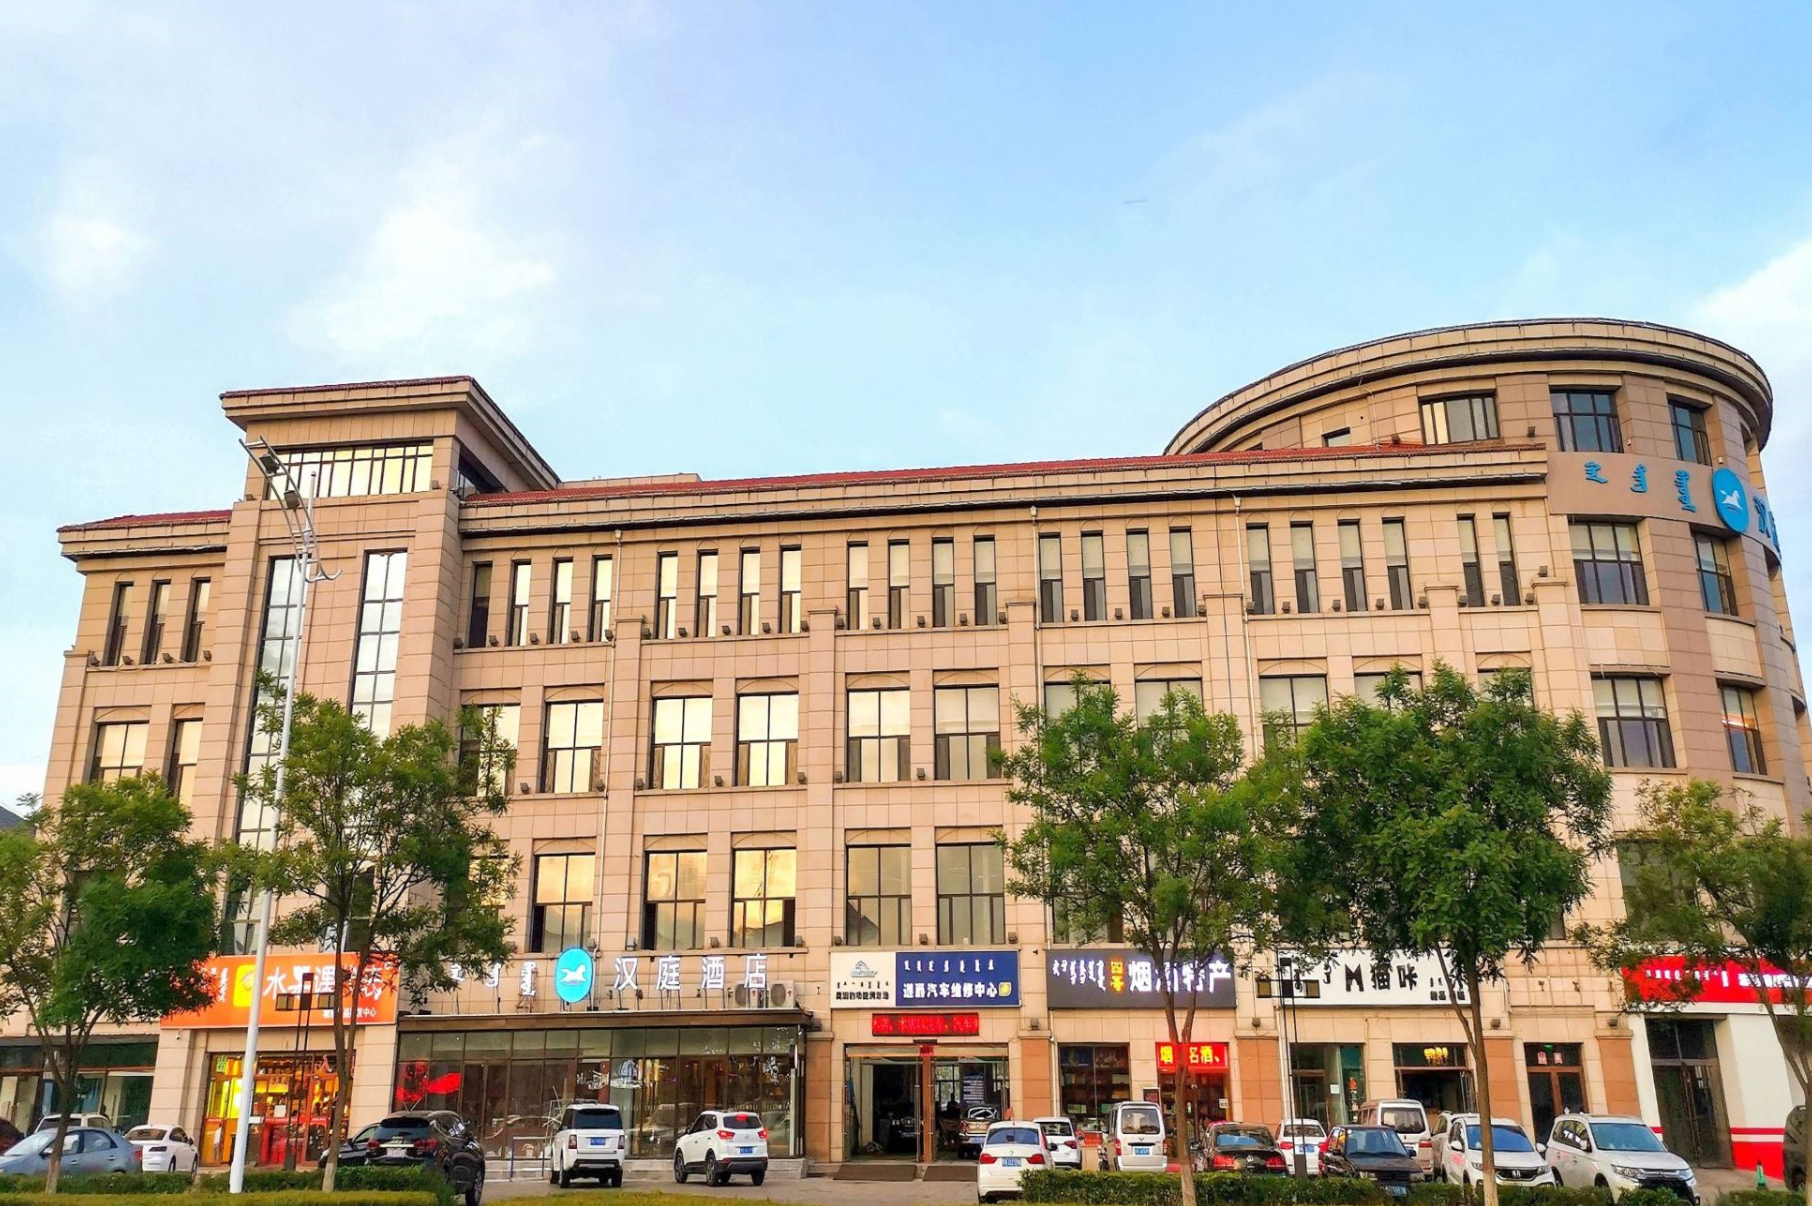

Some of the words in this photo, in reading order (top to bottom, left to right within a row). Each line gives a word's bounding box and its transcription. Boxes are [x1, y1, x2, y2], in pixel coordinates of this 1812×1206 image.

[613, 953, 768, 991] 汉庭酒店
[1160, 1045, 1220, 1064] 烟名酒、
